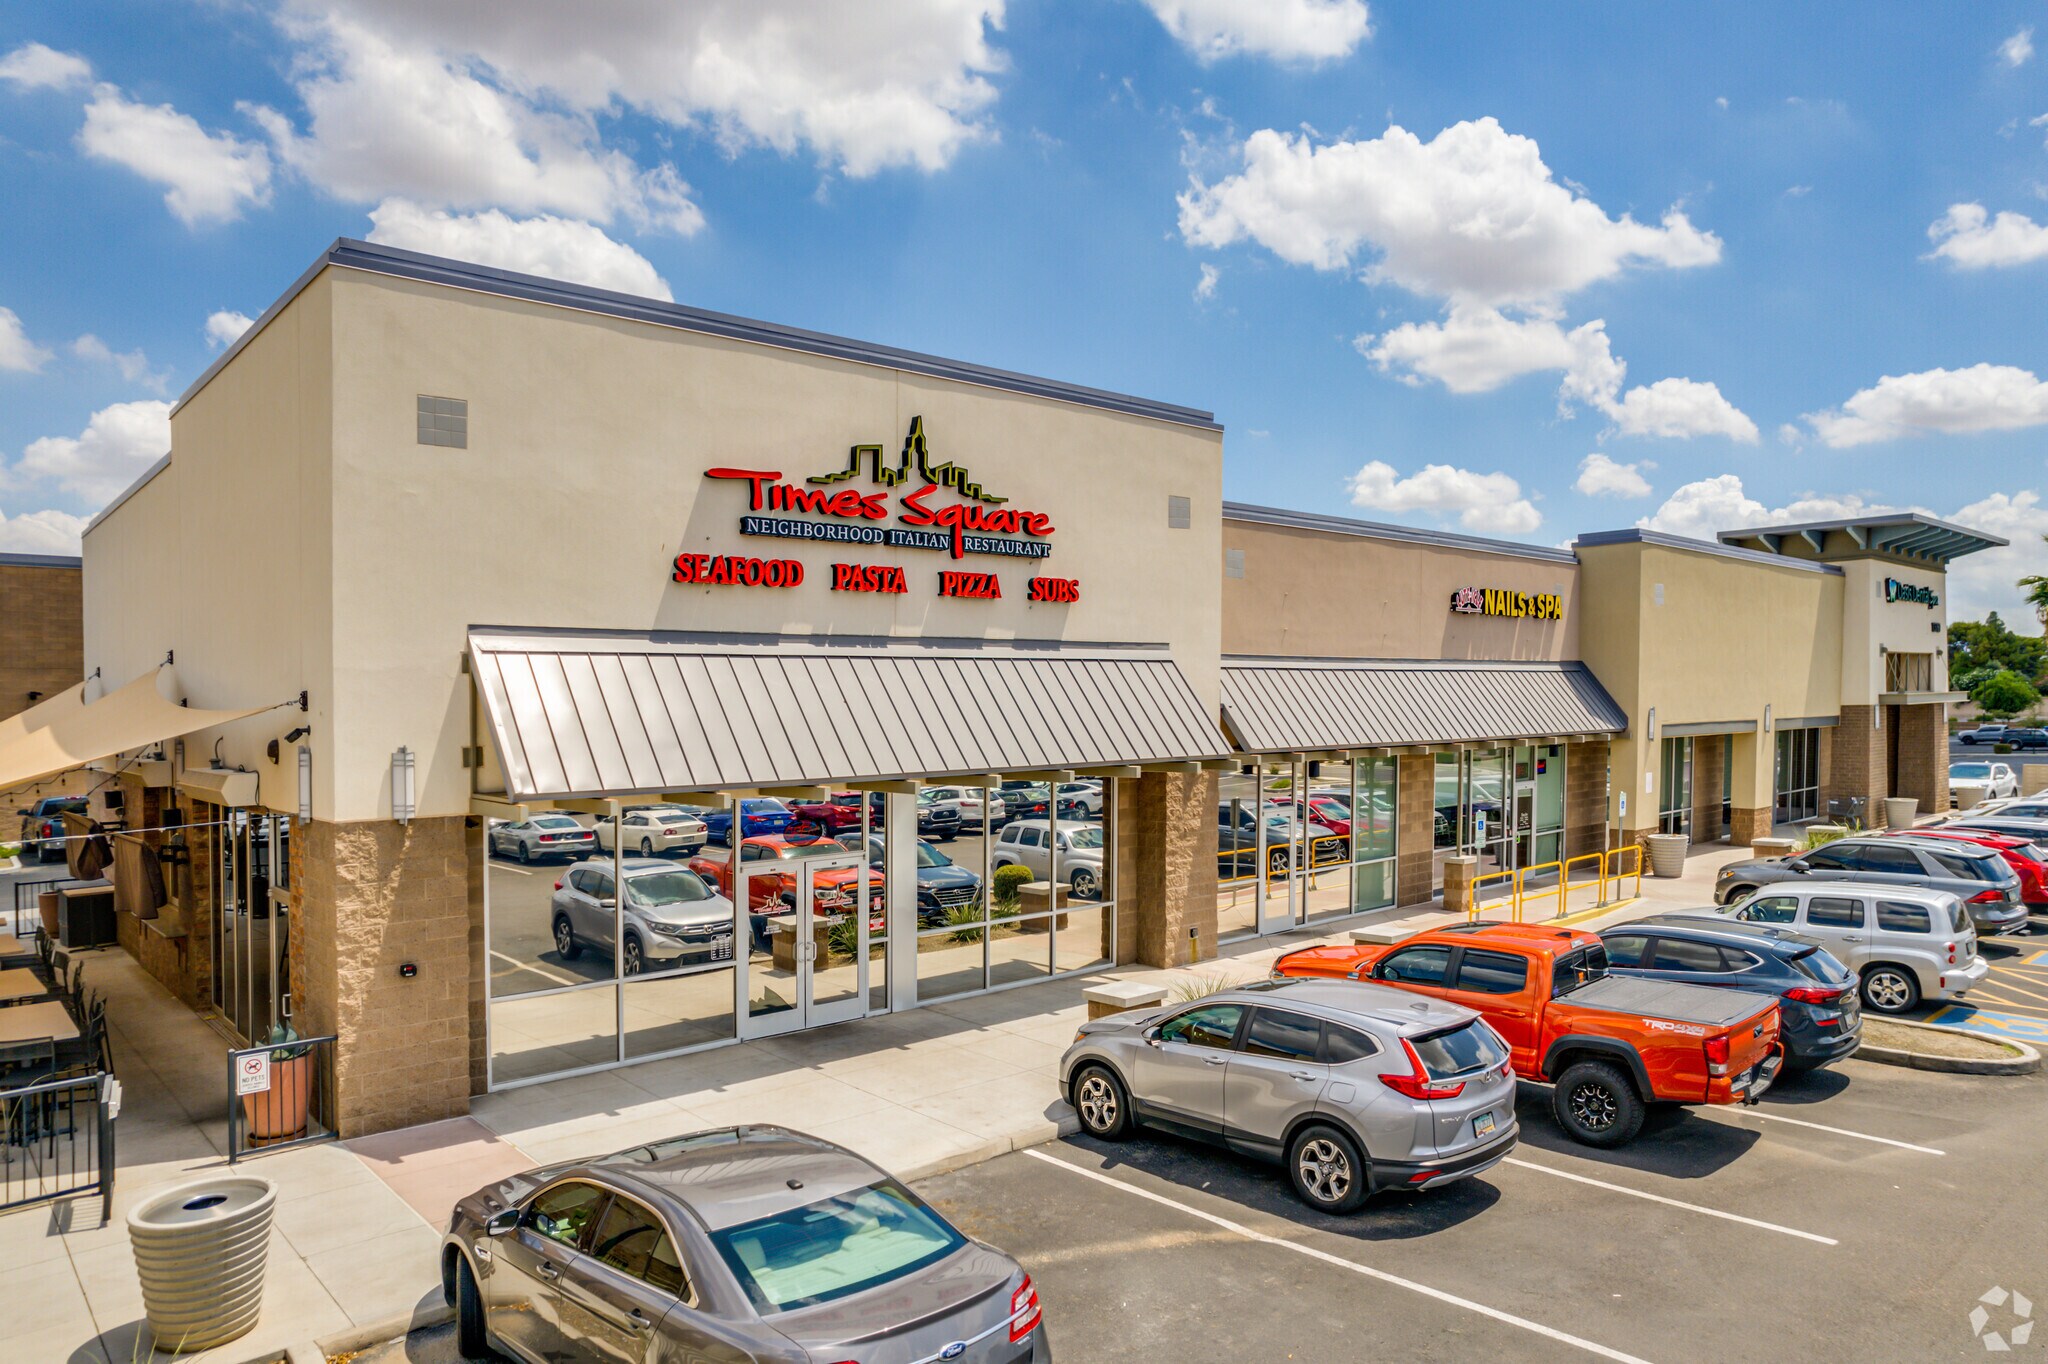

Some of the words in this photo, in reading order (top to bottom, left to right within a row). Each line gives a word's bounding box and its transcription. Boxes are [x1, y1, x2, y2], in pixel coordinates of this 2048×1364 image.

[704, 467, 888, 520] Times
[898, 483, 1055, 559] Square
[746, 518, 885, 544] NEIGHBORHOOD
[891, 531, 949, 549] ITALIAN
[964, 537, 1051, 557] RESTAURANT
[673, 553, 805, 588] SEAFOOD
[831, 563, 909, 593] PASTA
[938, 571, 1002, 599] PIZZA
[1028, 576, 1080, 602] SUBS
[1484, 588, 1527, 618] NAILS
[1528, 597, 1536, 616] &
[1537, 593, 1562, 620] SPA
[1642, 1019, 1675, 1031] TRD
[946, 1344, 963, 1358] Ford
